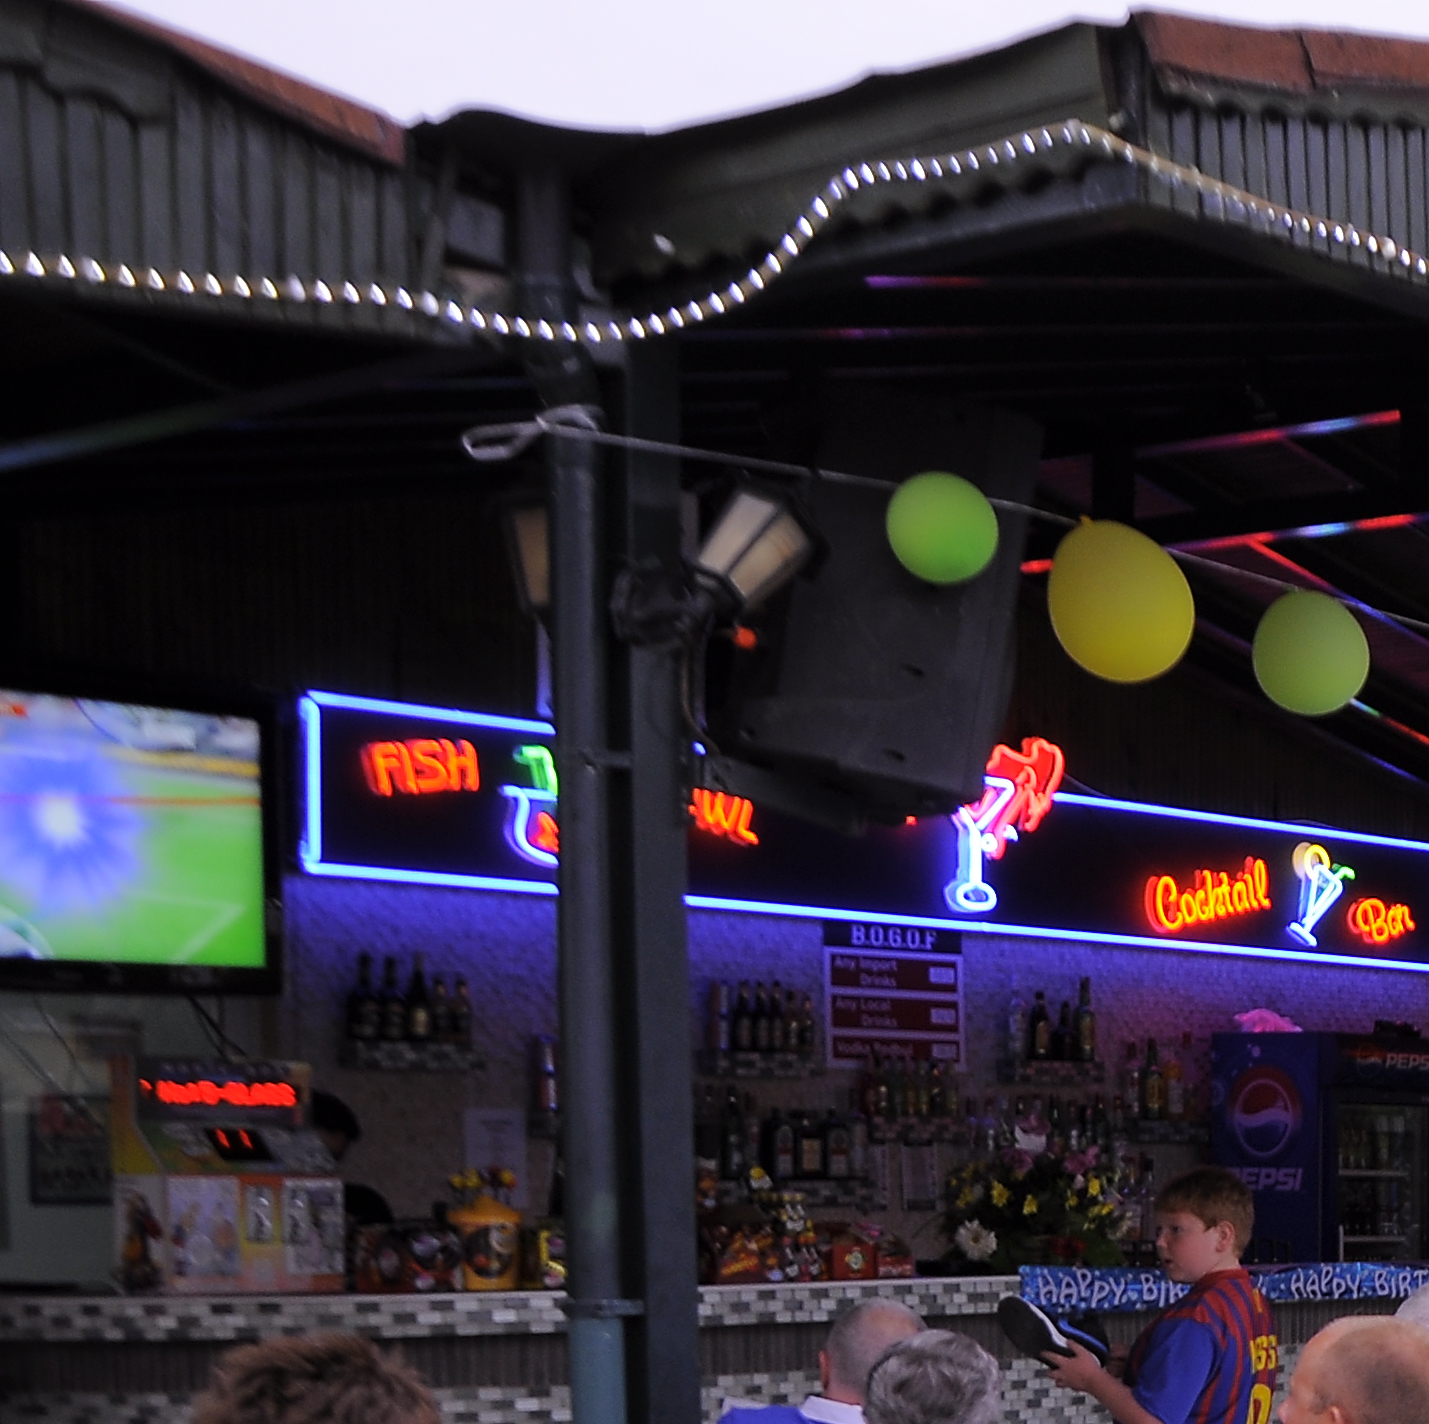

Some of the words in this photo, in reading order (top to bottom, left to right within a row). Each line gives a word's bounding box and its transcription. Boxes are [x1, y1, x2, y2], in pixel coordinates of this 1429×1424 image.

[364, 738, 480, 797] FISH
[1147, 857, 1271, 933] Cocktail
[1038, 1267, 1127, 1308] HAPPY
[1289, 1265, 1360, 1300] HAPPY
